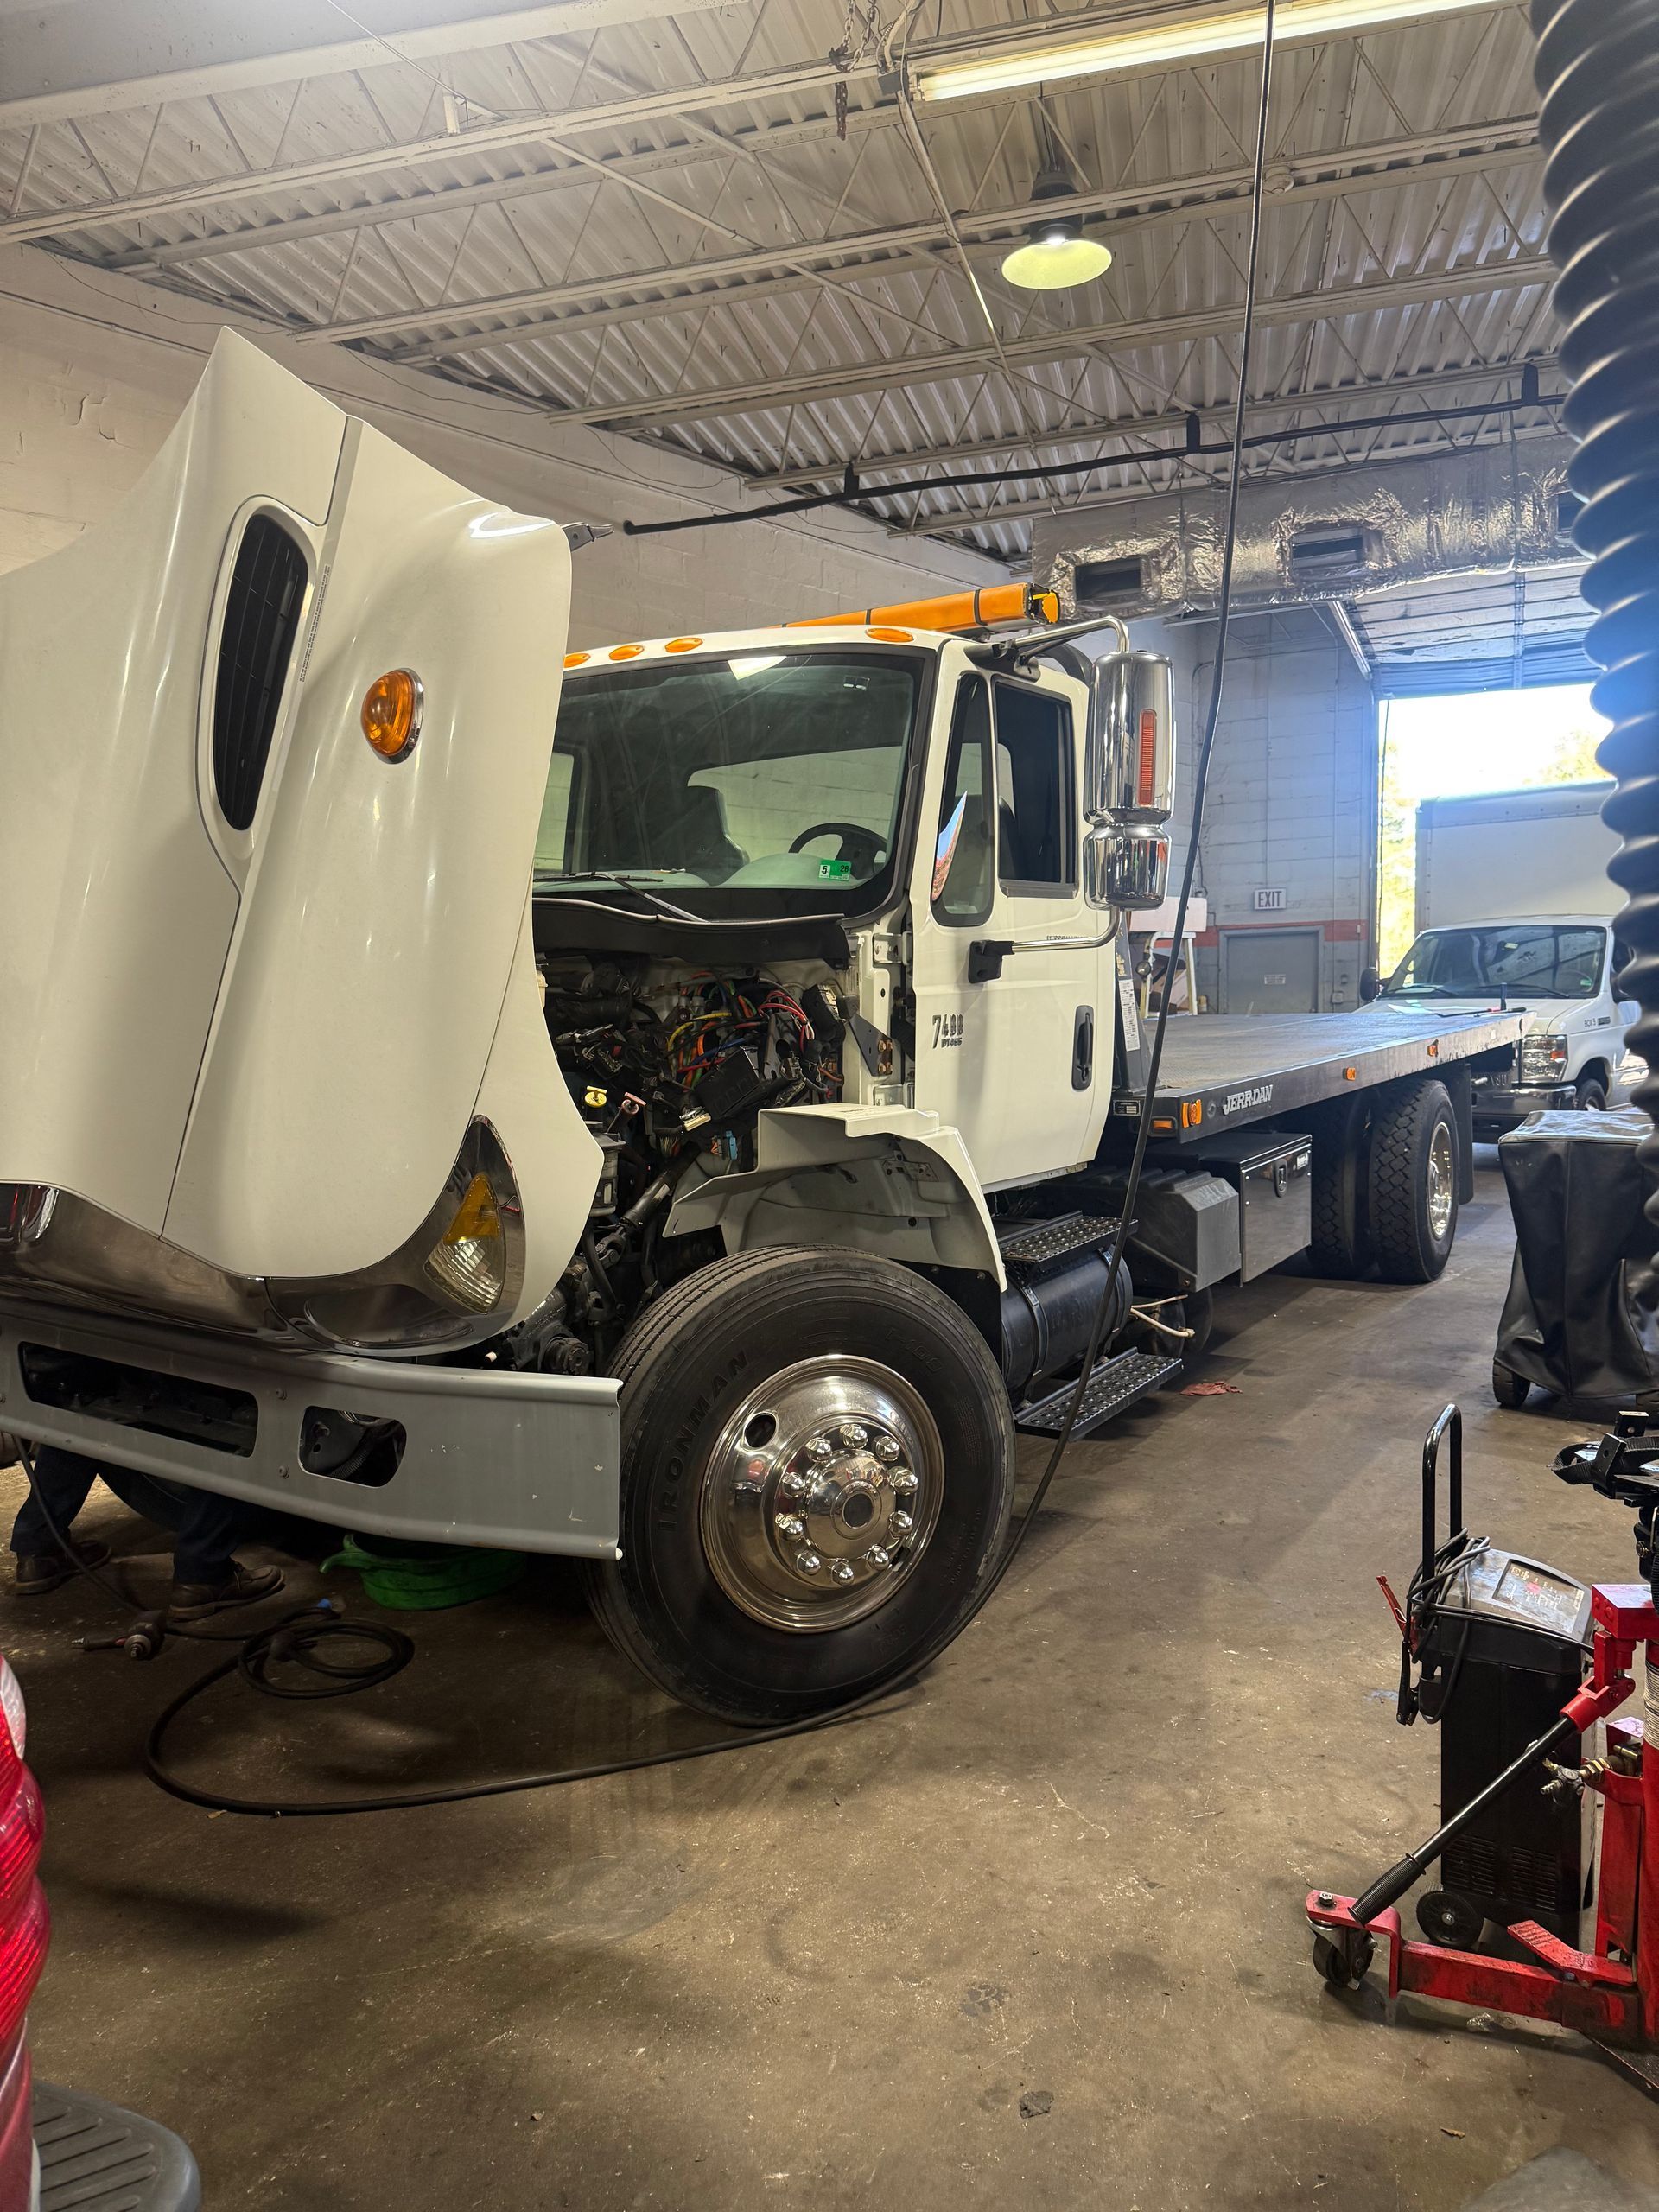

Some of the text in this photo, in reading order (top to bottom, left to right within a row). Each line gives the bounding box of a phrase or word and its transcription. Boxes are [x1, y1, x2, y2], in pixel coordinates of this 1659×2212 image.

[822, 865, 828, 874] 5
[1258, 891, 1282, 907] EXIT
[657, 1350, 748, 1532] IRONMAN
